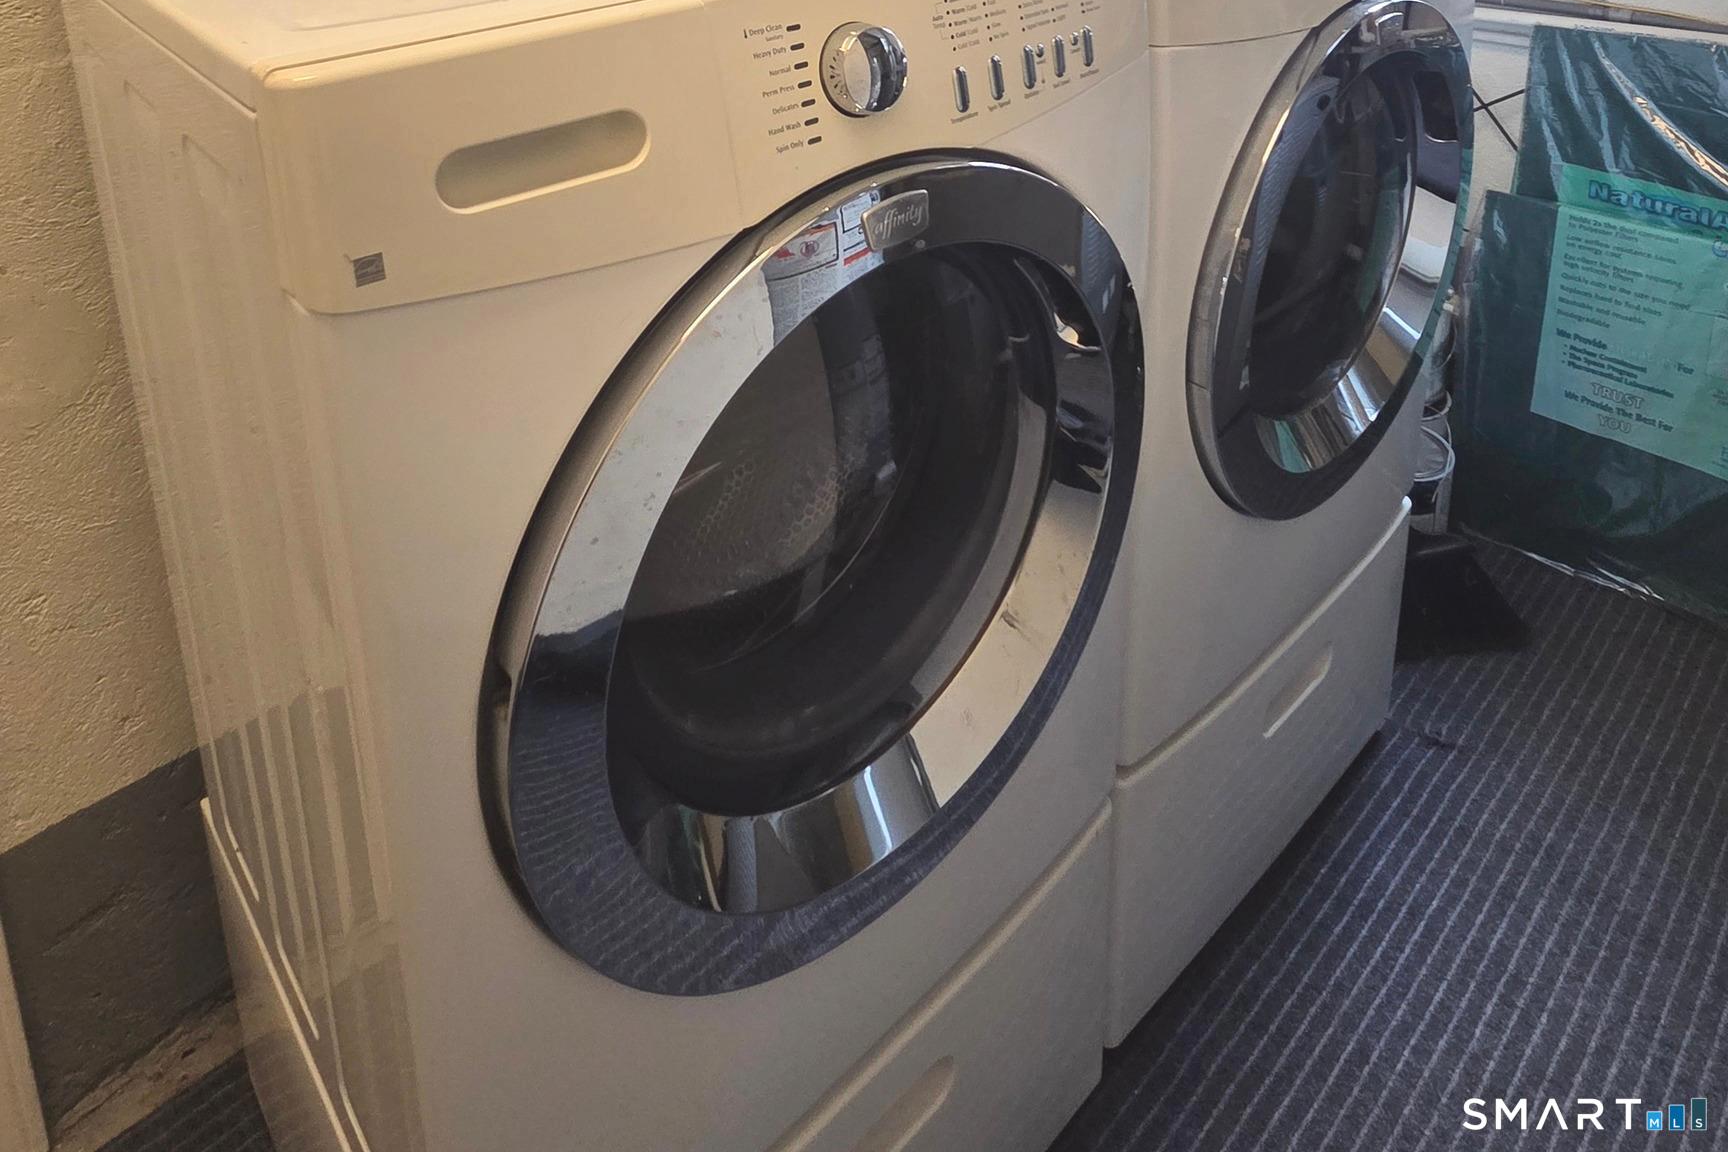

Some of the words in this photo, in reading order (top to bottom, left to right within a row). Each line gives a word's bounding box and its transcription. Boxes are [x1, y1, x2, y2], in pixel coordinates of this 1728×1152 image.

[749, 28, 765, 37] Deep
[765, 24, 783, 32] Clean
[752, 51, 772, 60] Heavy
[772, 47, 787, 55] Duty
[769, 64, 791, 77] Normal
[762, 89, 779, 98] Perm
[779, 85, 795, 94] Press
[772, 103, 799, 115] Delicates
[768, 125, 785, 136] Hand
[785, 121, 802, 130] Wash
[874, 204, 922, 240] affinity
[1556, 328, 1572, 339] We
[1573, 333, 1608, 349] Provide
[1677, 362, 1695, 375] For
[1590, 381, 1646, 409] TRUST
[1564, 390, 1579, 402] We
[1580, 395, 1614, 413] Provide
[1615, 407, 1633, 419] The
[1635, 413, 1657, 427] Best
[1658, 418, 1675, 433] For
[1597, 414, 1632, 434] YOU
